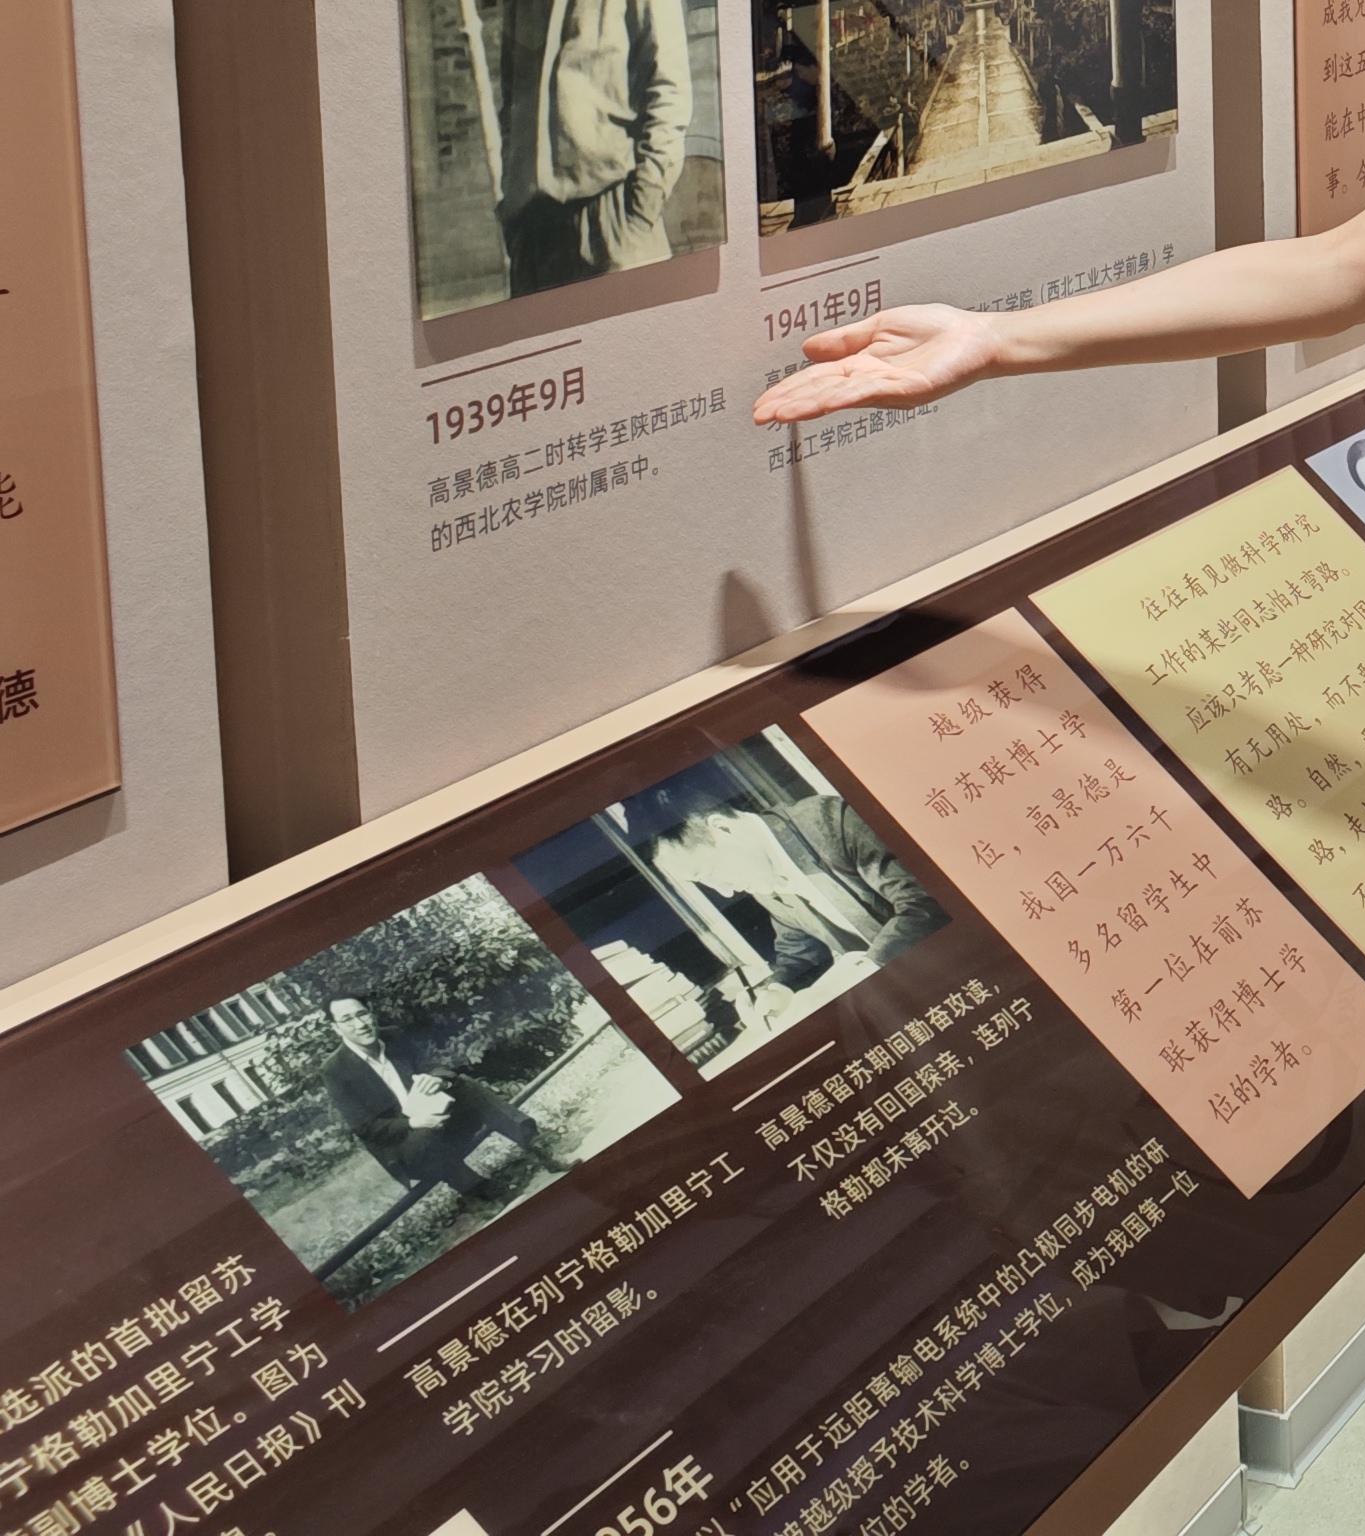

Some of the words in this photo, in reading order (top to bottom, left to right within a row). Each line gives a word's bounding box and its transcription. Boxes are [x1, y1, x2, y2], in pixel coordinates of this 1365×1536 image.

[762, 278, 885, 344] 1941年9月
[425, 365, 587, 446] 1939年9月
[427, 386, 728, 508] 高景德高二时转学至陕西武功县
[430, 452, 660, 553] 的西北农学院附属高中。
[1139, 512, 1323, 624] 往往看见做科学研究
[1144, 561, 1352, 688] 工作的某些同志怕走弯路。
[926, 662, 1050, 744] 越级获得
[924, 708, 1092, 822] 前苏联博士学
[971, 755, 1138, 870] 位，高景德是
[1019, 801, 1177, 923] 我国一万六千
[1066, 849, 1219, 975] 多名留学生中
[1110, 895, 1268, 1026] 第一位在前苏
[1157, 939, 1312, 1076] 联获得博士学
[754, 975, 1002, 1153] 高景德留苏期间勤奋攻读，
[786, 996, 1035, 1185] 不仅没有回国探亲，连列宁
[1206, 1037, 1315, 1127] 位的学者。
[819, 1106, 980, 1221] 格勒都未离开过。
[403, 1150, 746, 1400] 高景德在列宁格勒加里宁工
[441, 1279, 660, 1440] 学院学习时留影。
[4, 1341, 329, 1536] 副博士学位。图为
